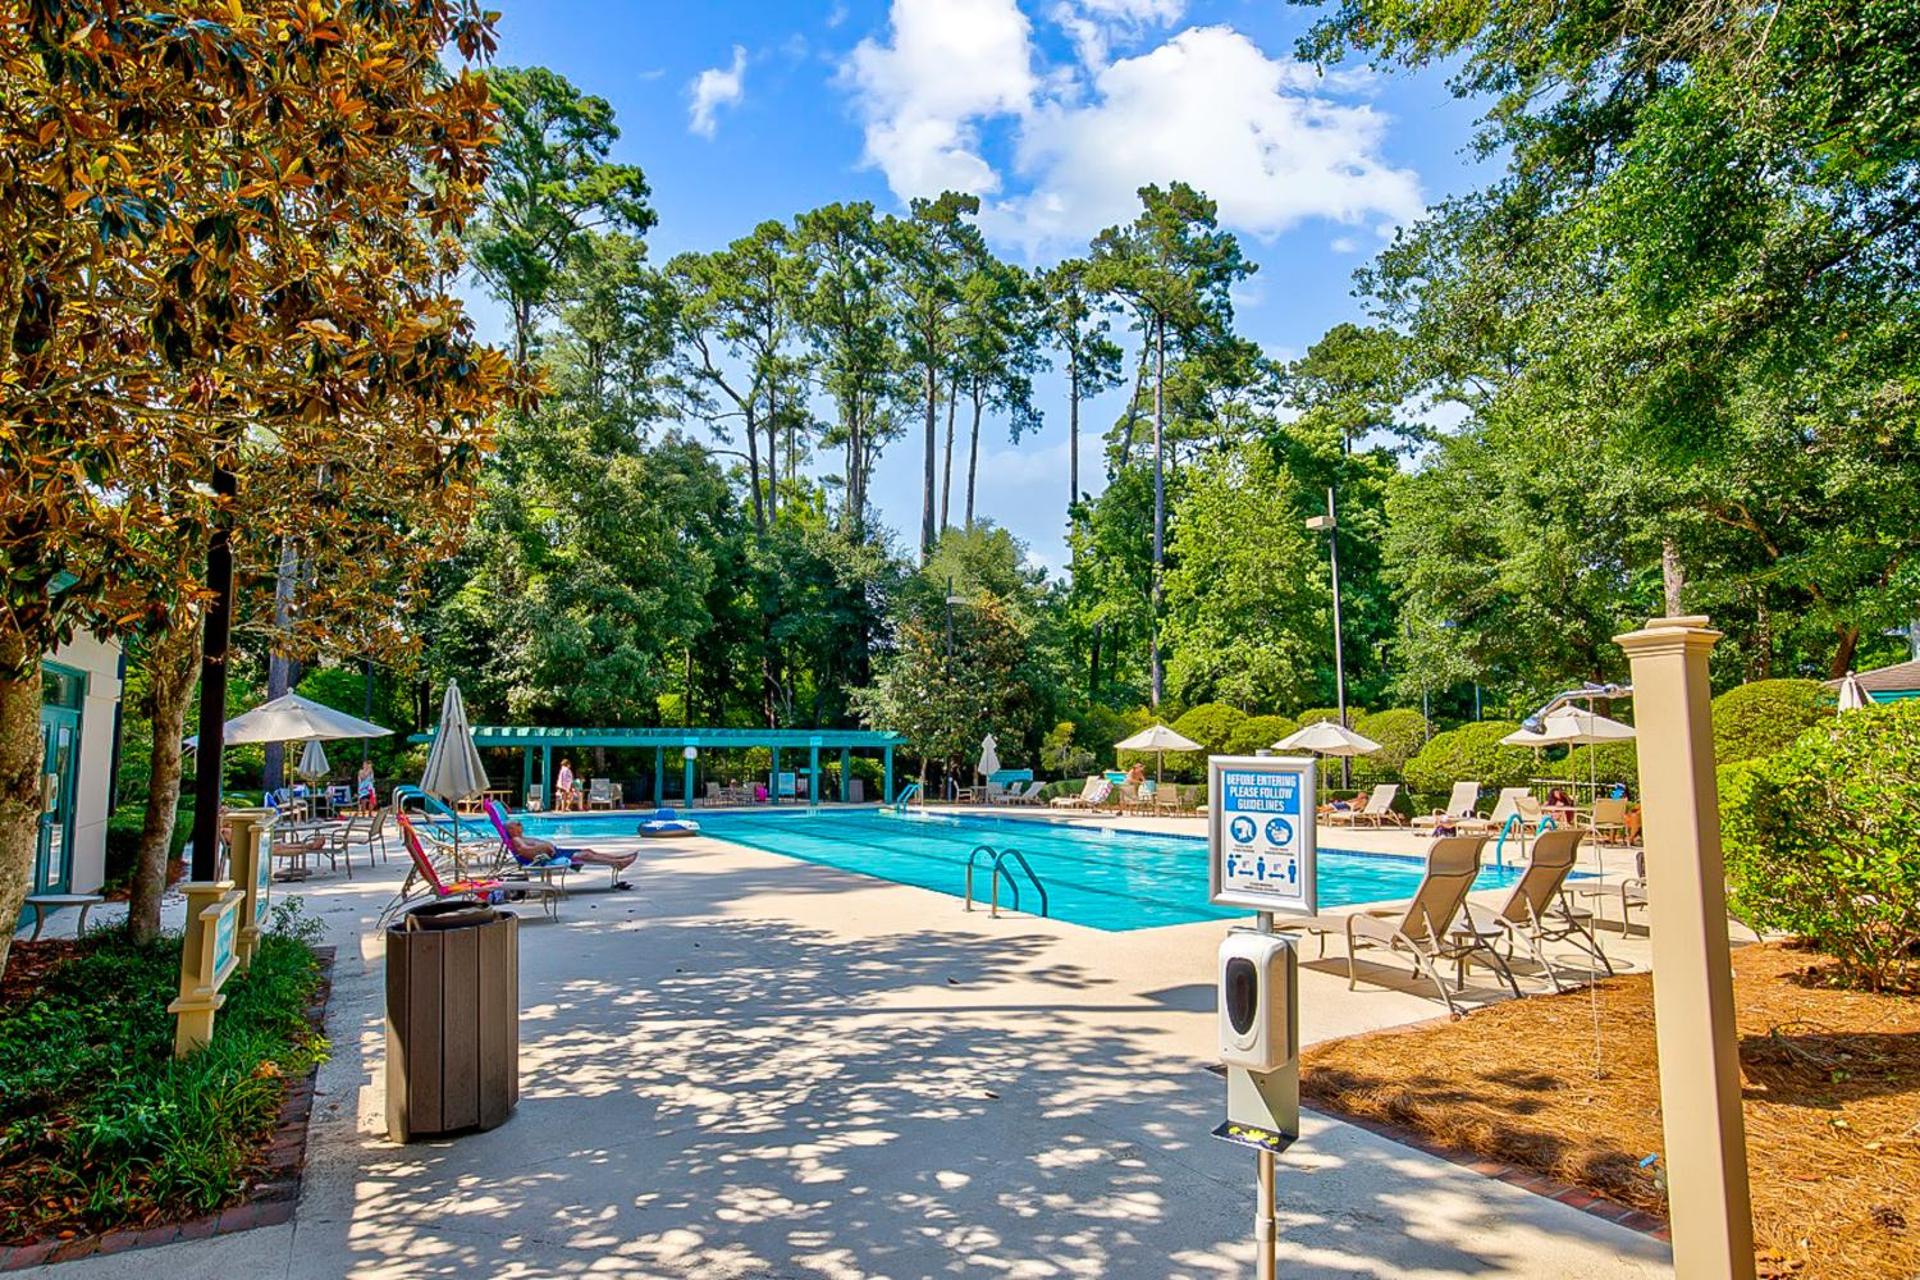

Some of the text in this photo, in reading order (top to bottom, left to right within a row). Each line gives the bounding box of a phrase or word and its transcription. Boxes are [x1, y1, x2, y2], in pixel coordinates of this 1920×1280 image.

[1227, 773, 1296, 787] BEFORE ENTERING
[1230, 786, 1293, 799] PLEASE FOLLOW
[1237, 799, 1285, 811] GUIDELINES
